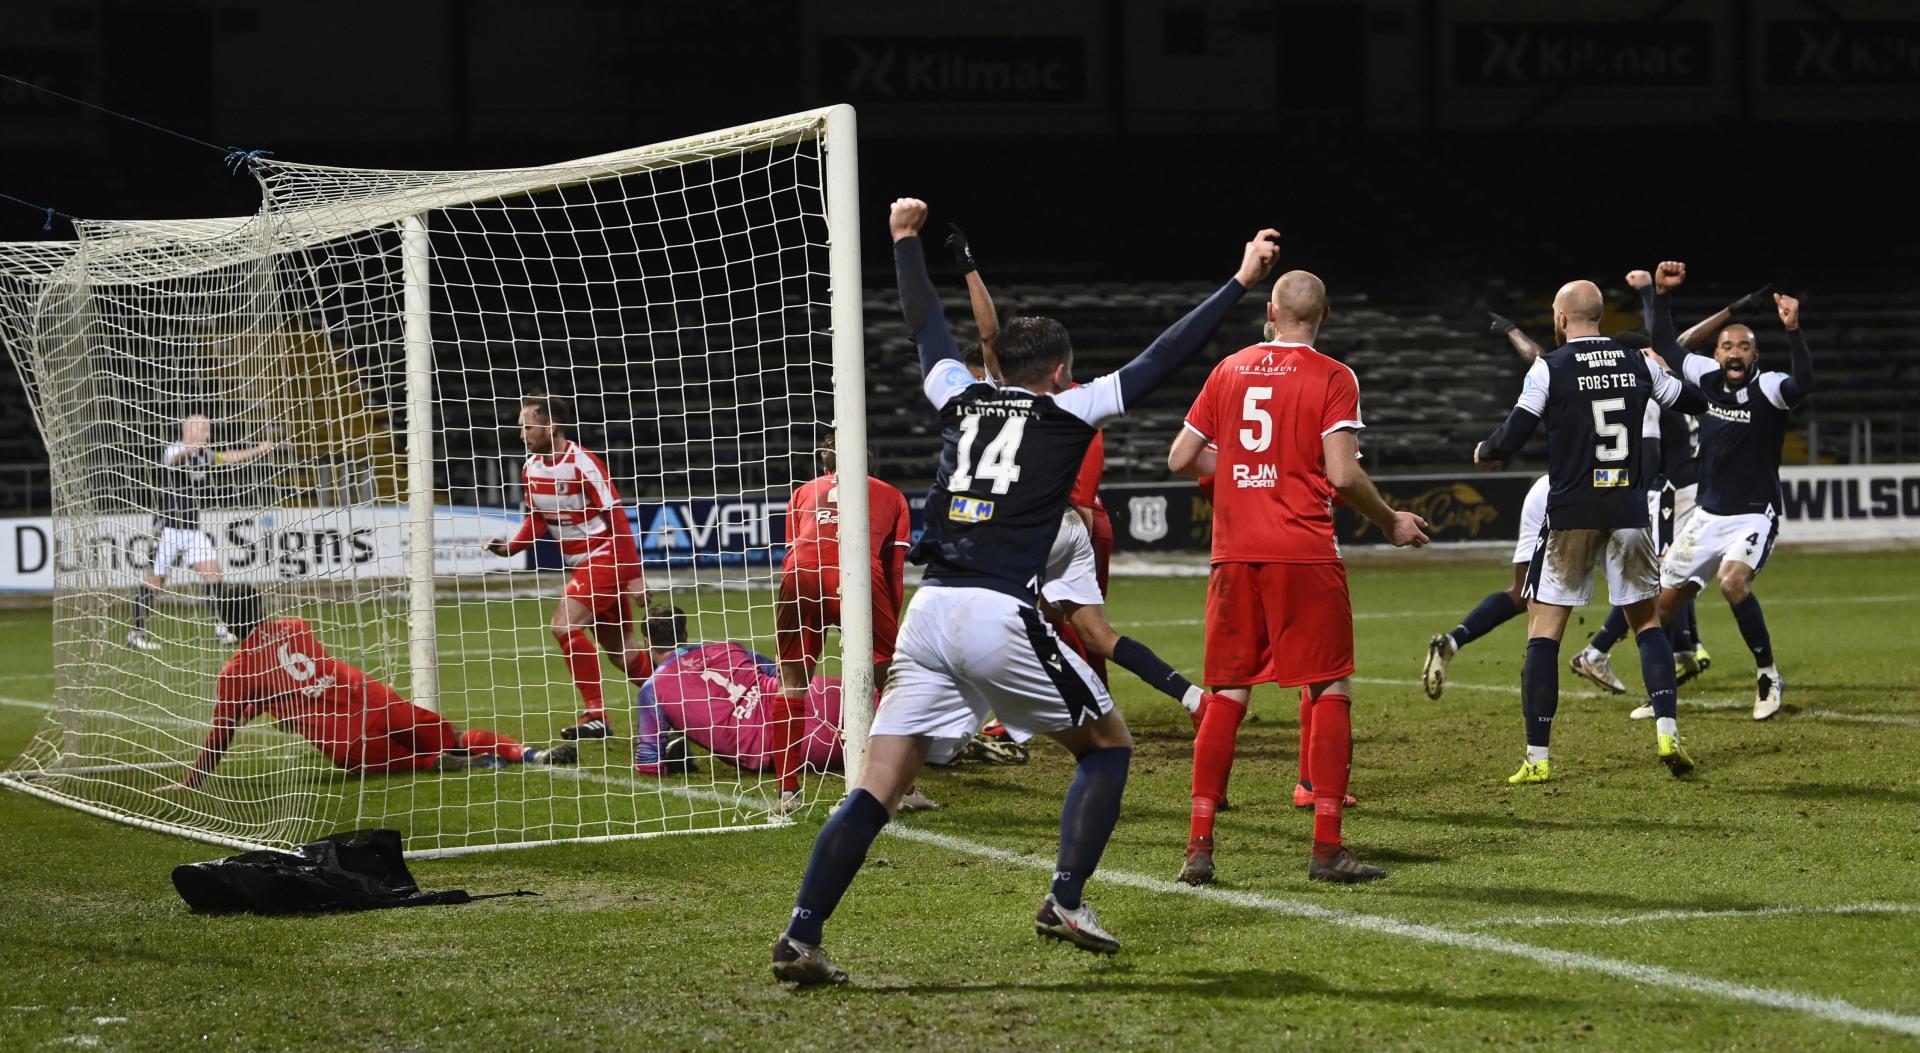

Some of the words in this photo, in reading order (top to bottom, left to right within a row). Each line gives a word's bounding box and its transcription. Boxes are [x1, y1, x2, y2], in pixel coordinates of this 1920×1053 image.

[906, 52, 1065, 91] Kilmac
[1575, 351, 1602, 362] SCOTT
[1602, 349, 1626, 360] FYFFE
[1588, 358, 1617, 368] MOTORS
[1577, 373, 1637, 391] FORSTER
[1240, 386, 1273, 453] 5
[1591, 397, 1629, 462] 5
[947, 413, 1028, 495] 14
[1233, 463, 1278, 481] RJM
[1237, 480, 1275, 489] SPORTS
[952, 497, 993, 517] MKM
[227, 517, 374, 577] Signs
[1745, 532, 1760, 546] 4
[277, 641, 316, 681] 6
[701, 669, 746, 704] 1
